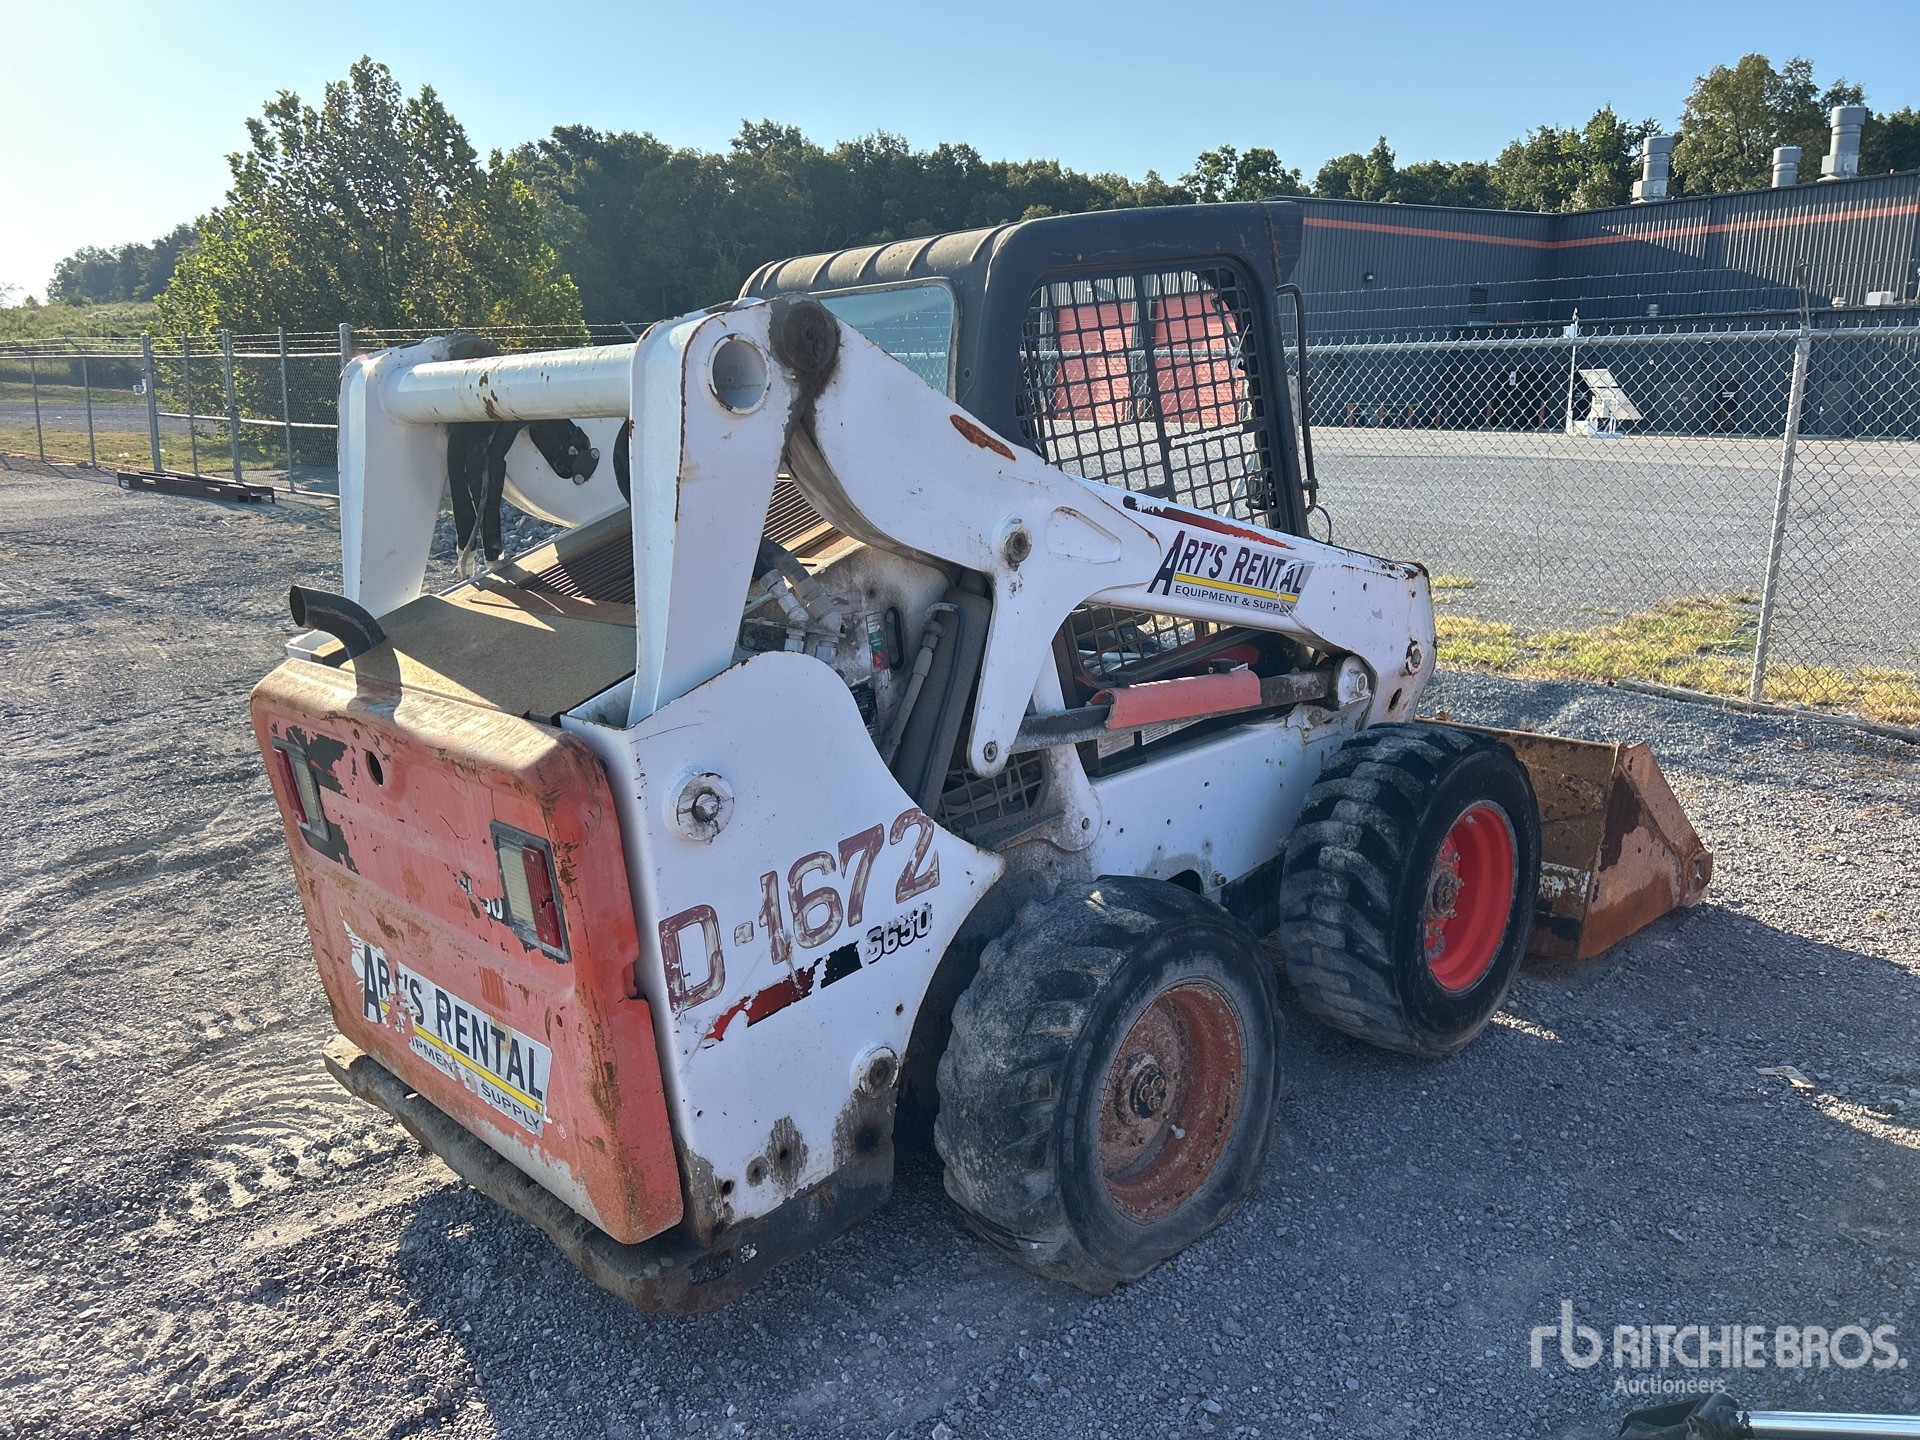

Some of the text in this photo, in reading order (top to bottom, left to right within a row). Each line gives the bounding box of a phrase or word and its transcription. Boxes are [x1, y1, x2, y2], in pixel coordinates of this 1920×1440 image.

[1147, 530, 1304, 596] ART'S RENTAL
[1174, 585, 1239, 604] EQUIPMENT
[1241, 597, 1250, 606] &
[658, 807, 940, 1014] D-1672
[865, 902, 933, 965] S650
[435, 988, 543, 1101] RENTAL
[481, 1083, 541, 1130] SUPPLY
